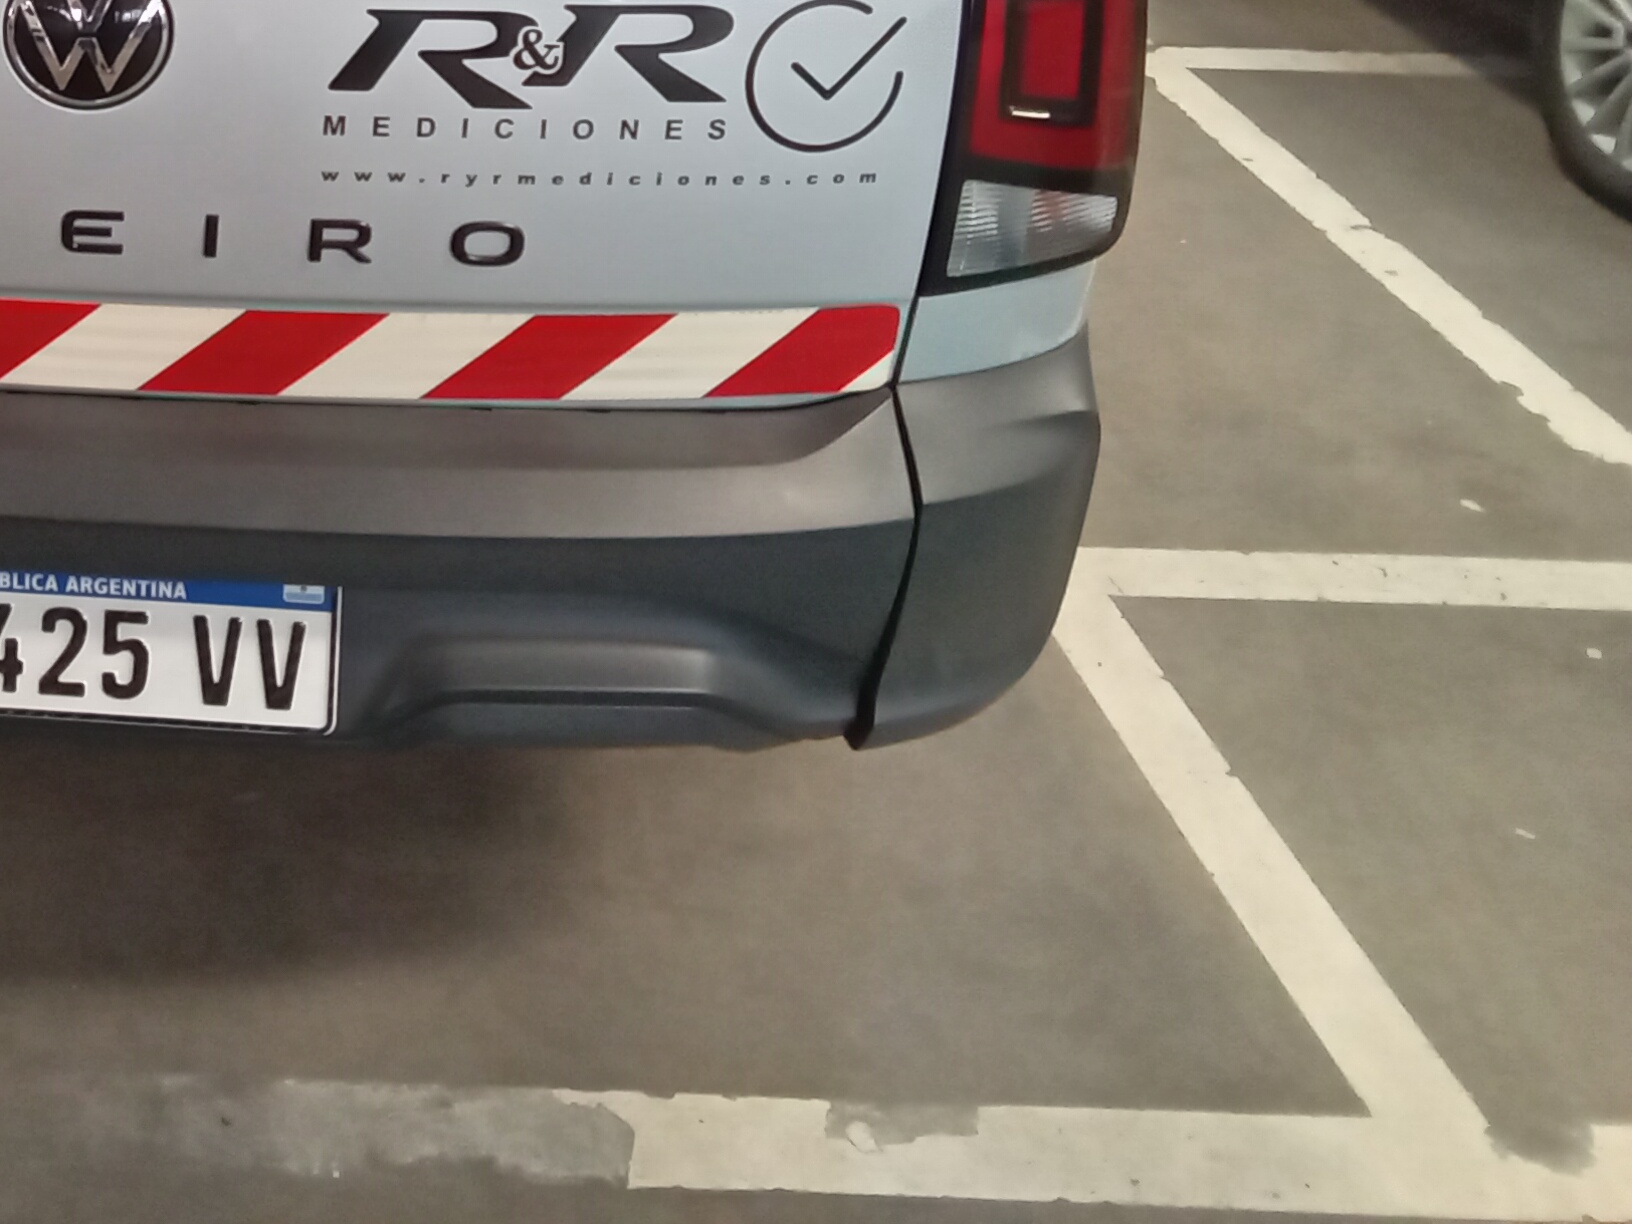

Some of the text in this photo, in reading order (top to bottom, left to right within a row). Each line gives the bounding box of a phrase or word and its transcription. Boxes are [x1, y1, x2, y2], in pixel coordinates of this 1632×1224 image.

[322, 115, 726, 141] MEDICIONES
[321, 171, 877, 188] www.ryrmediciones.com
[65, 575, 187, 600] ARGENTINA
[193, 615, 306, 711] VV
